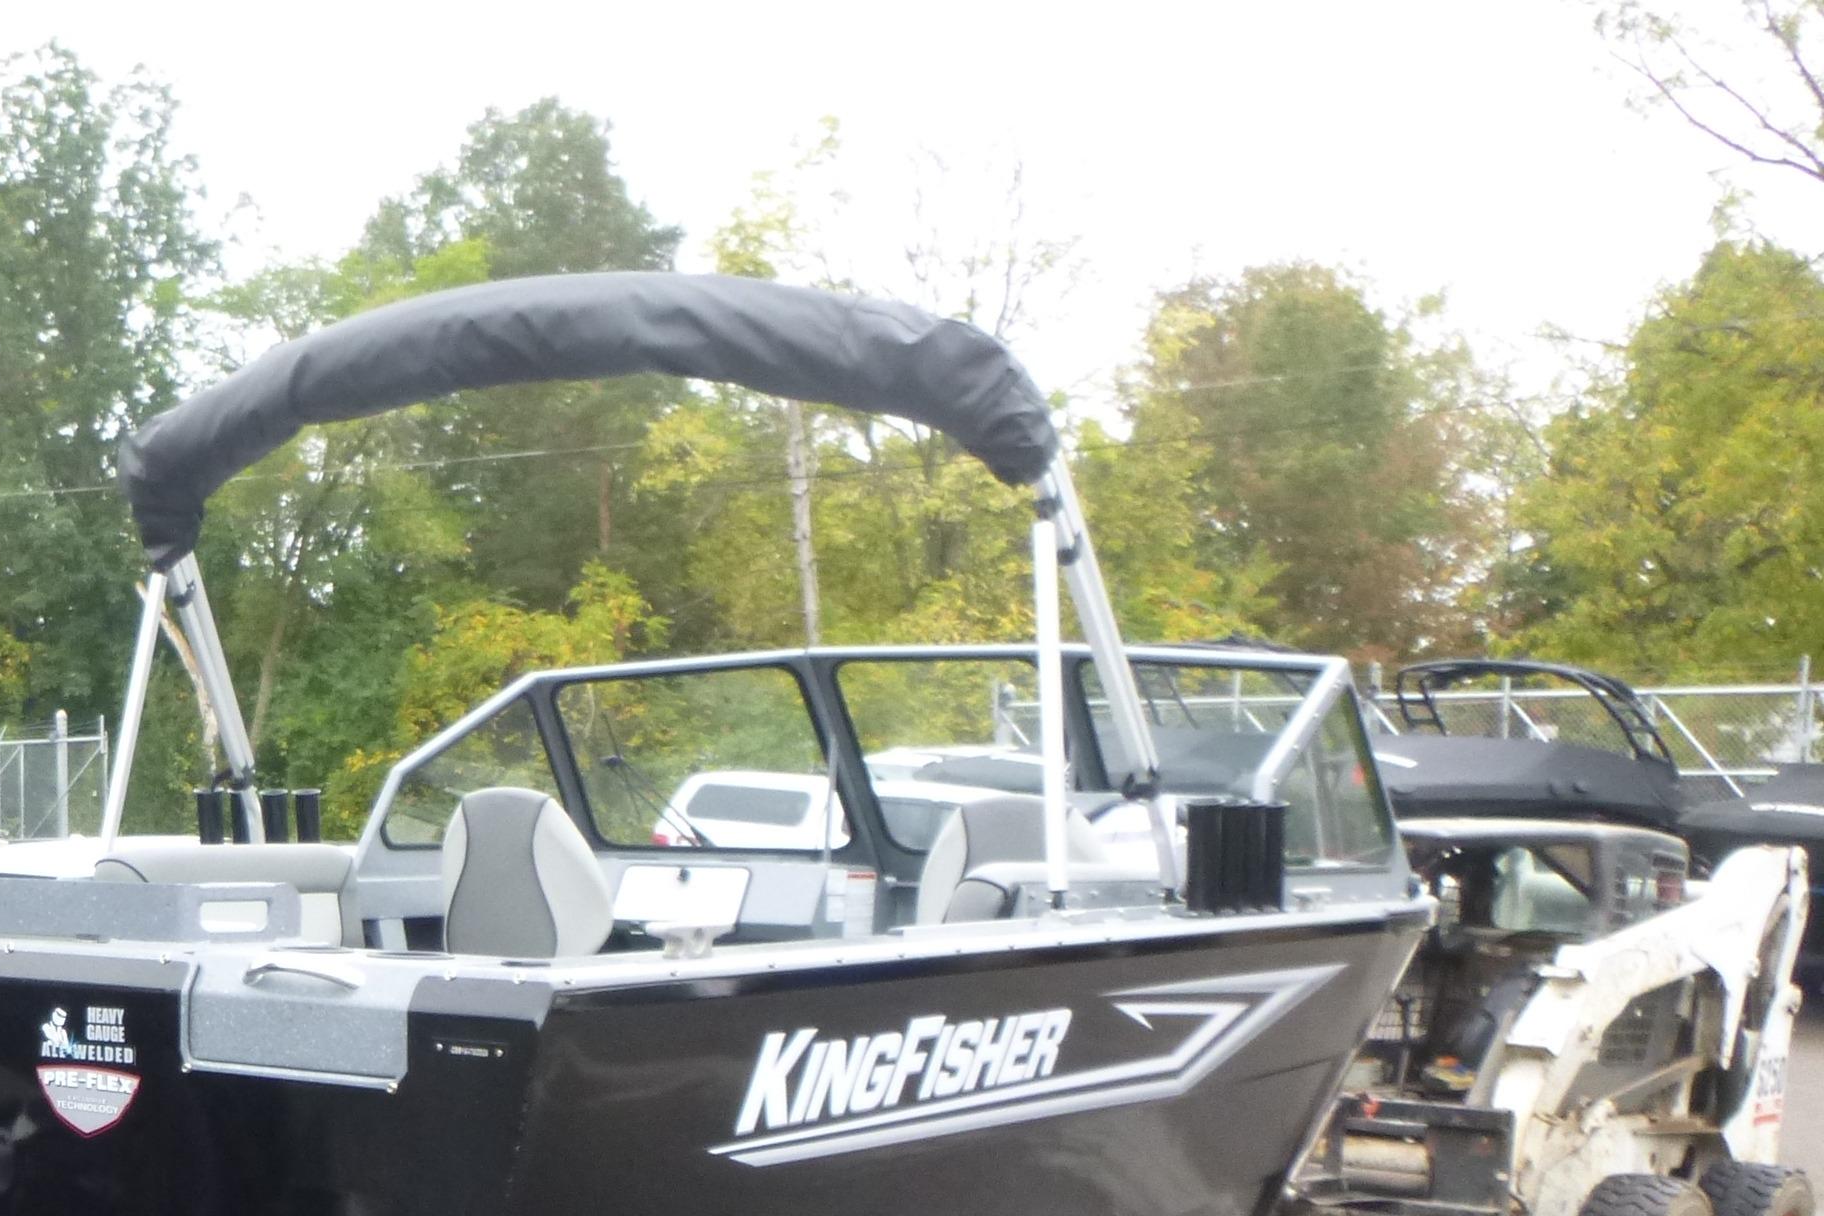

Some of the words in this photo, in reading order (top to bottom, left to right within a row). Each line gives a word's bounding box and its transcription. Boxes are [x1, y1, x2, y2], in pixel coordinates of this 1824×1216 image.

[87, 1007, 124, 1025] HEAVY
[87, 1024, 125, 1043] GAUGE
[72, 1044, 134, 1063] WELDED
[734, 1008, 1072, 1136] KINGFISHER
[43, 1071, 133, 1094] PRE-FLEX
[57, 1100, 118, 1114] TECHNOLOGY
